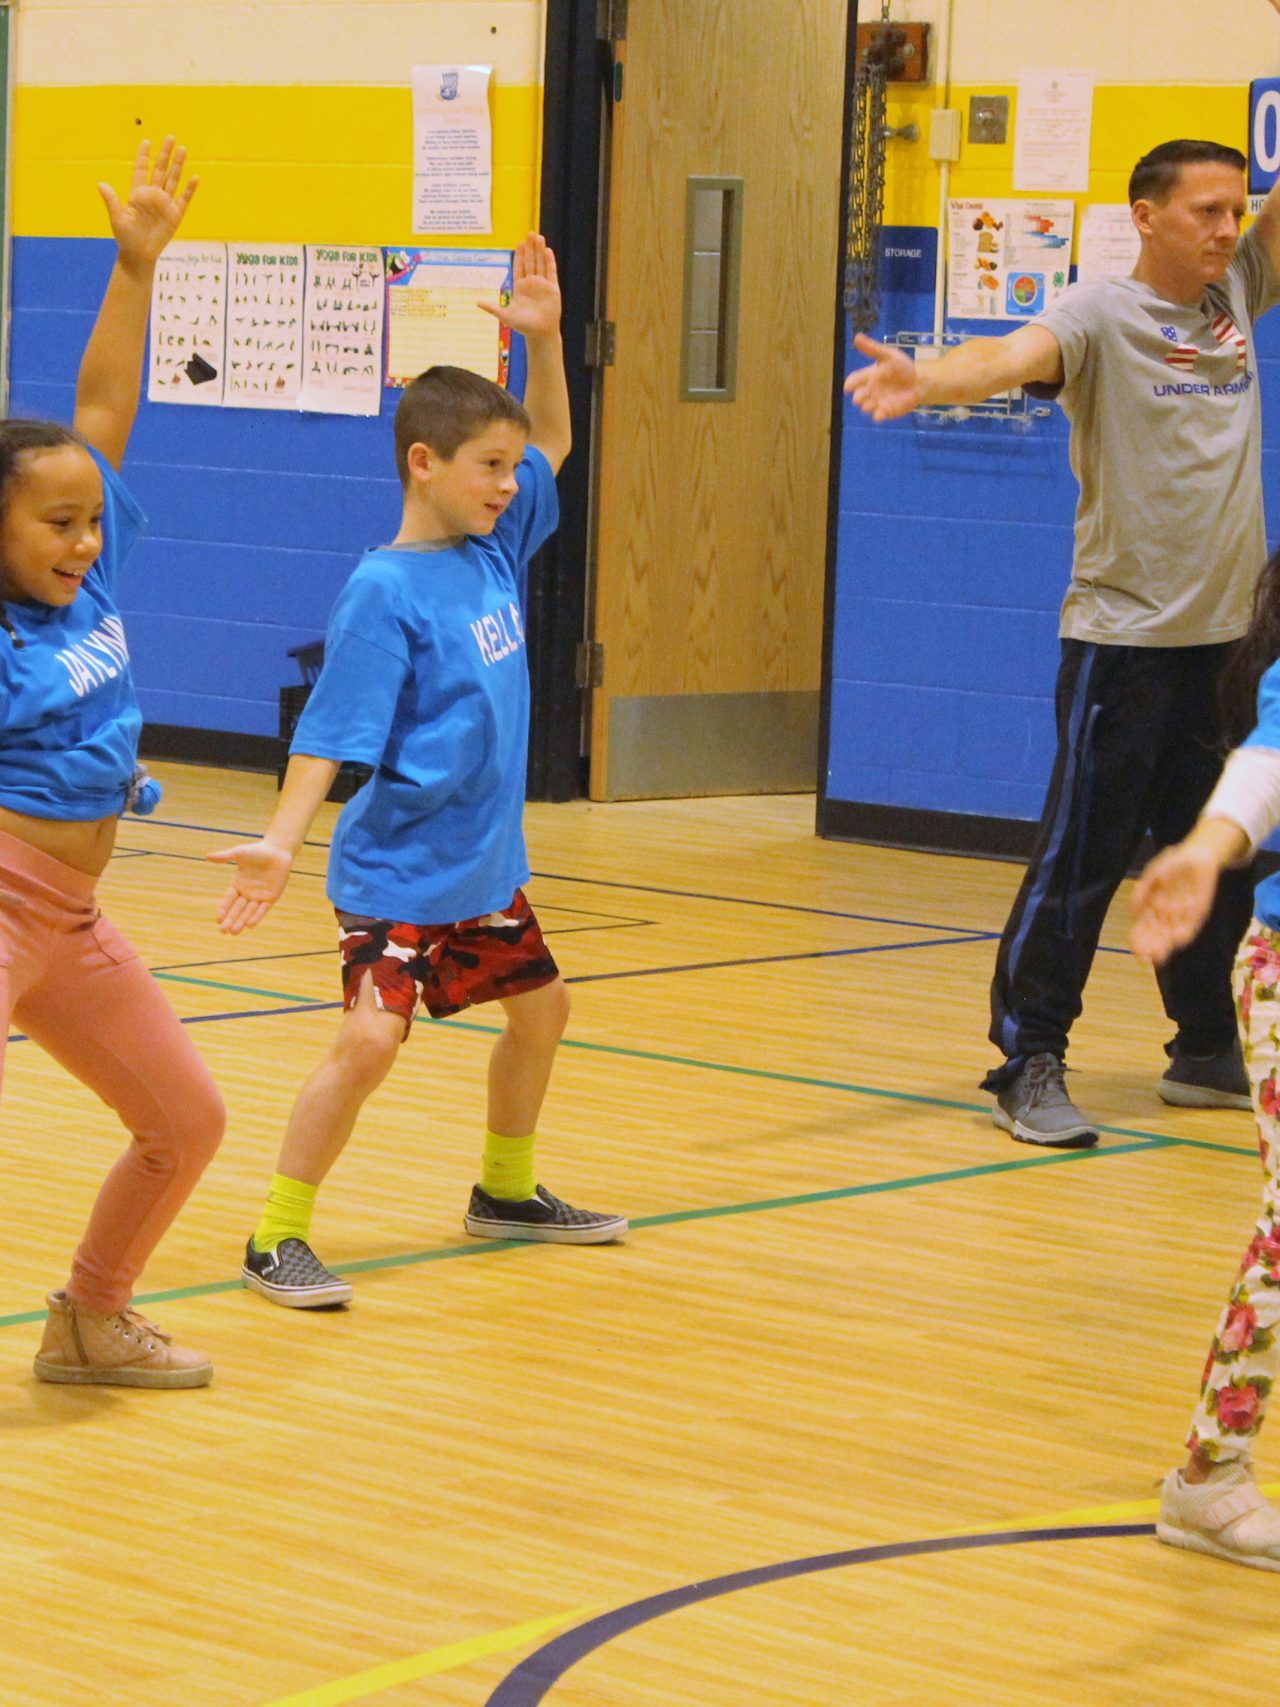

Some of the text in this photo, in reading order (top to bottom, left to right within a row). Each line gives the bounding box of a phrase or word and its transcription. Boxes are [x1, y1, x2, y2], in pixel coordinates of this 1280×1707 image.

[884, 248, 922, 259] STORAGE
[1153, 371, 1255, 397] UNDER ARM
